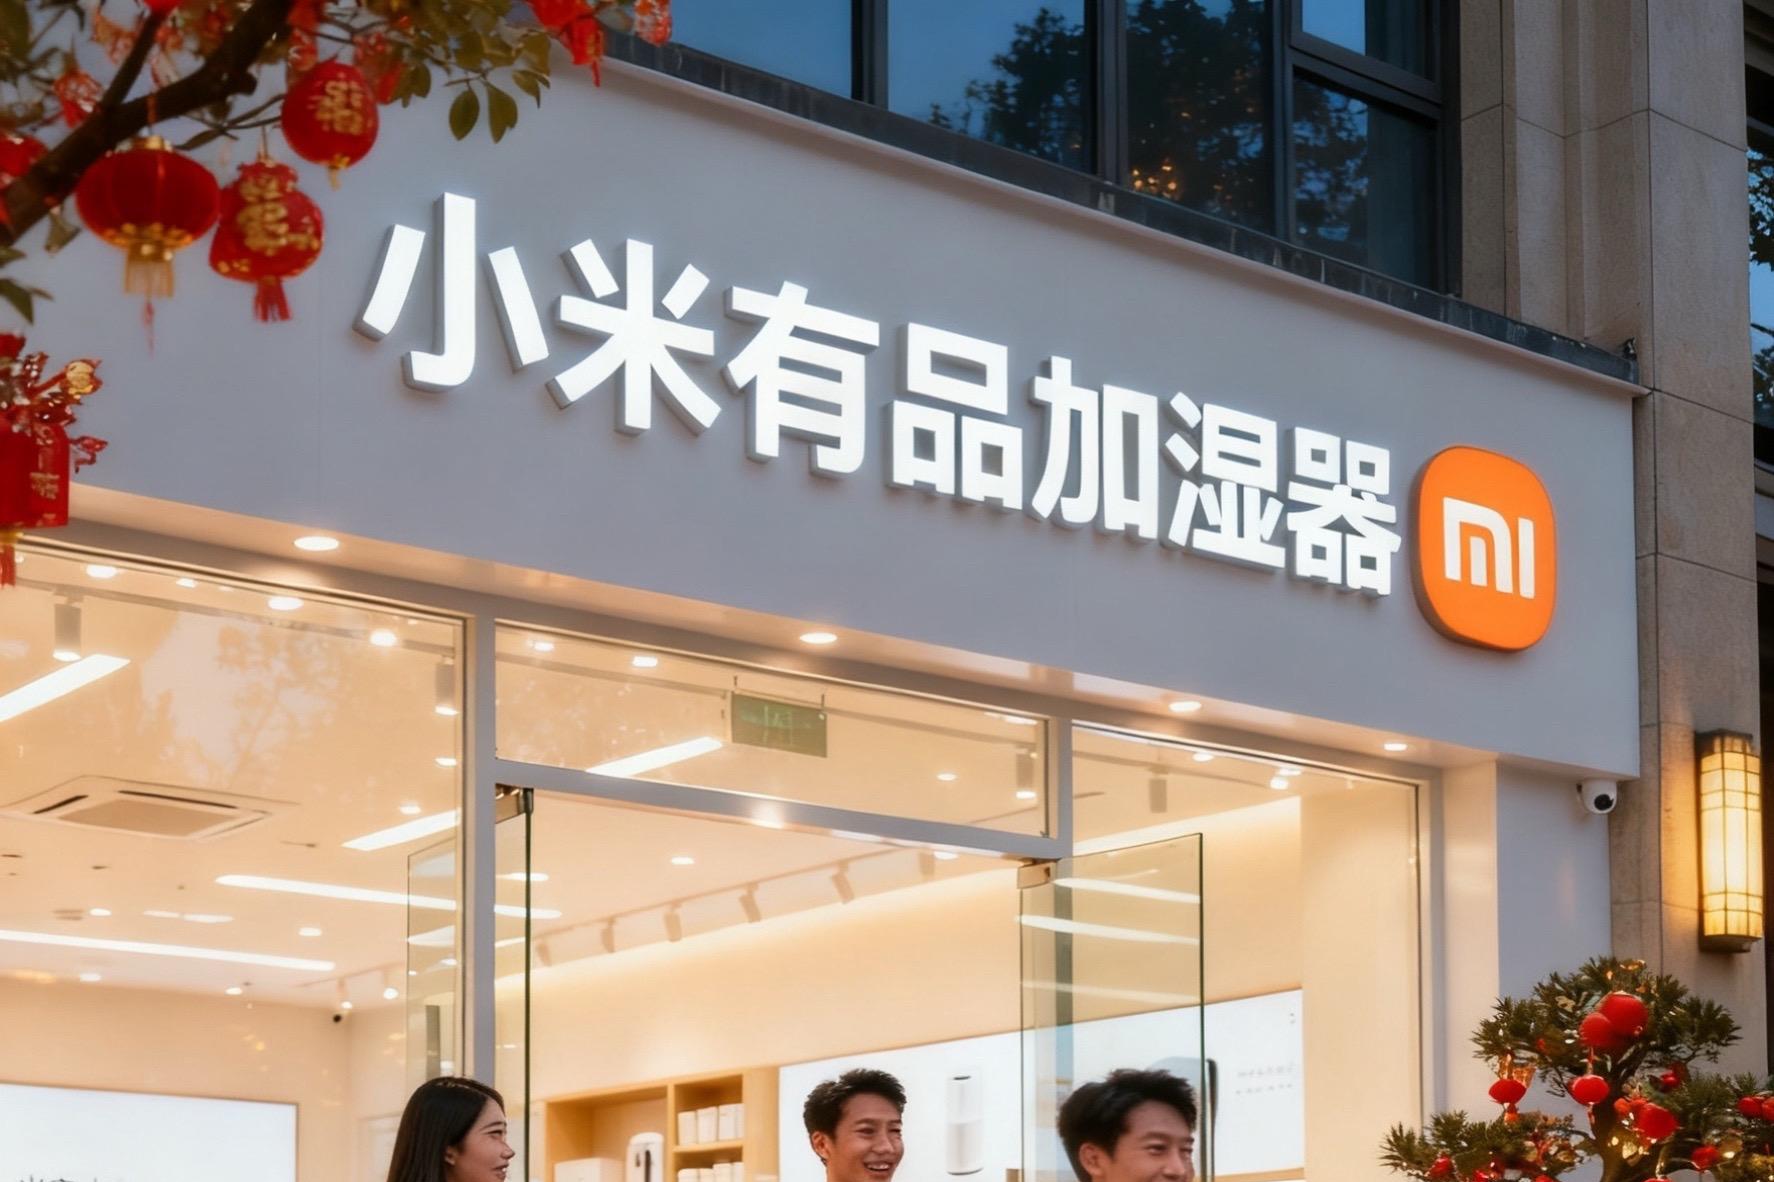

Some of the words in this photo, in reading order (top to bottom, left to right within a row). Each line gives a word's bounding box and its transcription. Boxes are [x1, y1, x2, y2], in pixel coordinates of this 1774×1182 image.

[353, 191, 1402, 597] 小米有品加湿器
